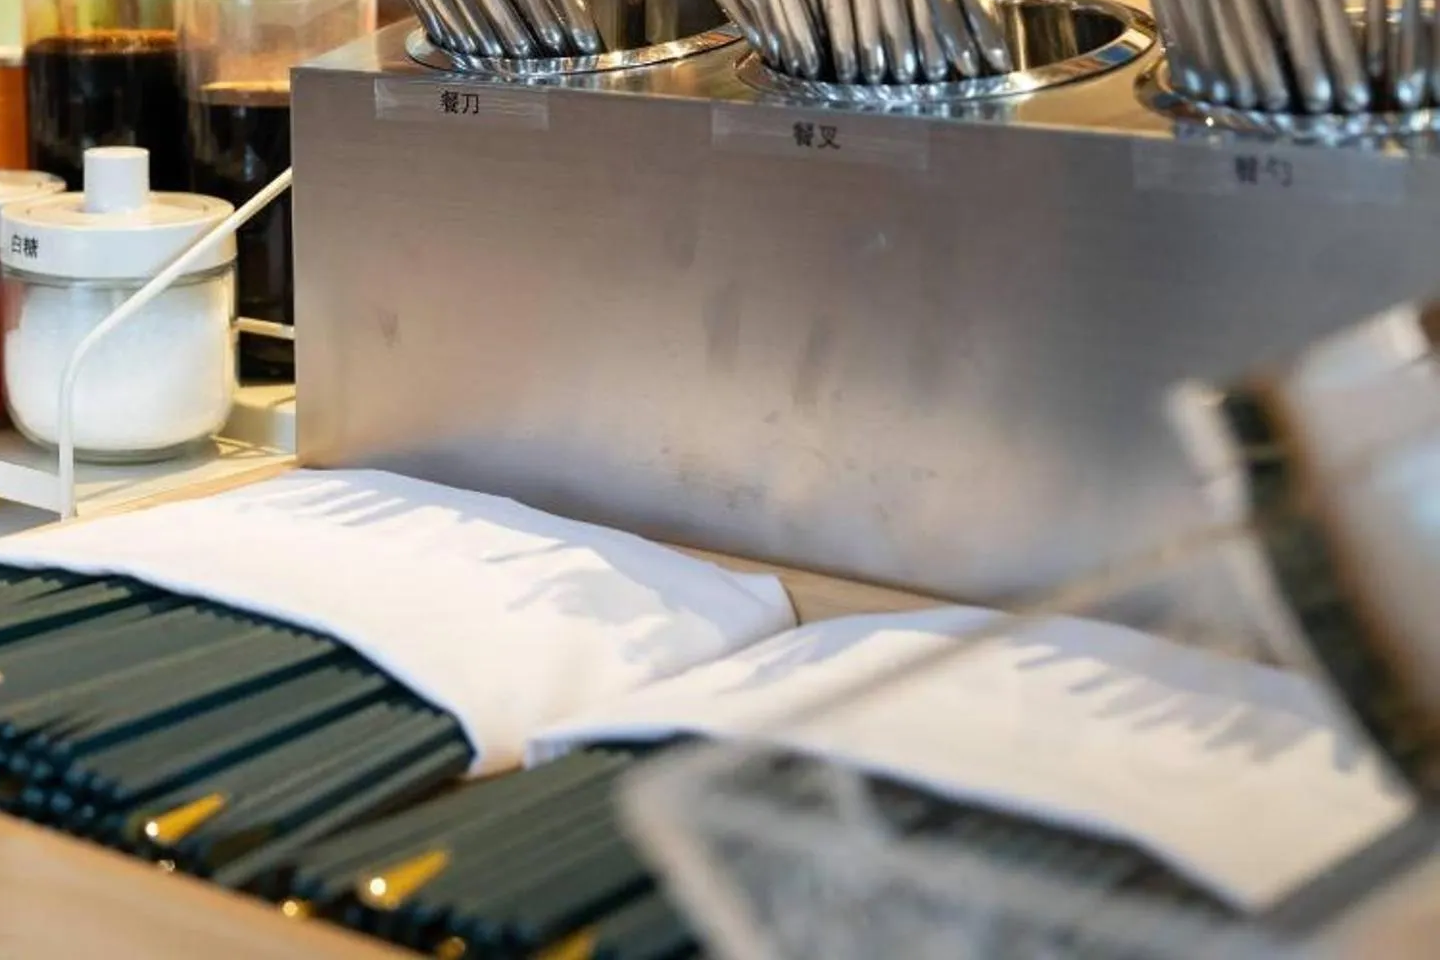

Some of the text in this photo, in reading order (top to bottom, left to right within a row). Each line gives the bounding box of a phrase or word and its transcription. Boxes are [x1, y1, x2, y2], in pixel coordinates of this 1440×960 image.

[441, 90, 480, 115] 餐刀
[793, 121, 841, 149] 餐叉
[11, 233, 40, 259] 白糖
